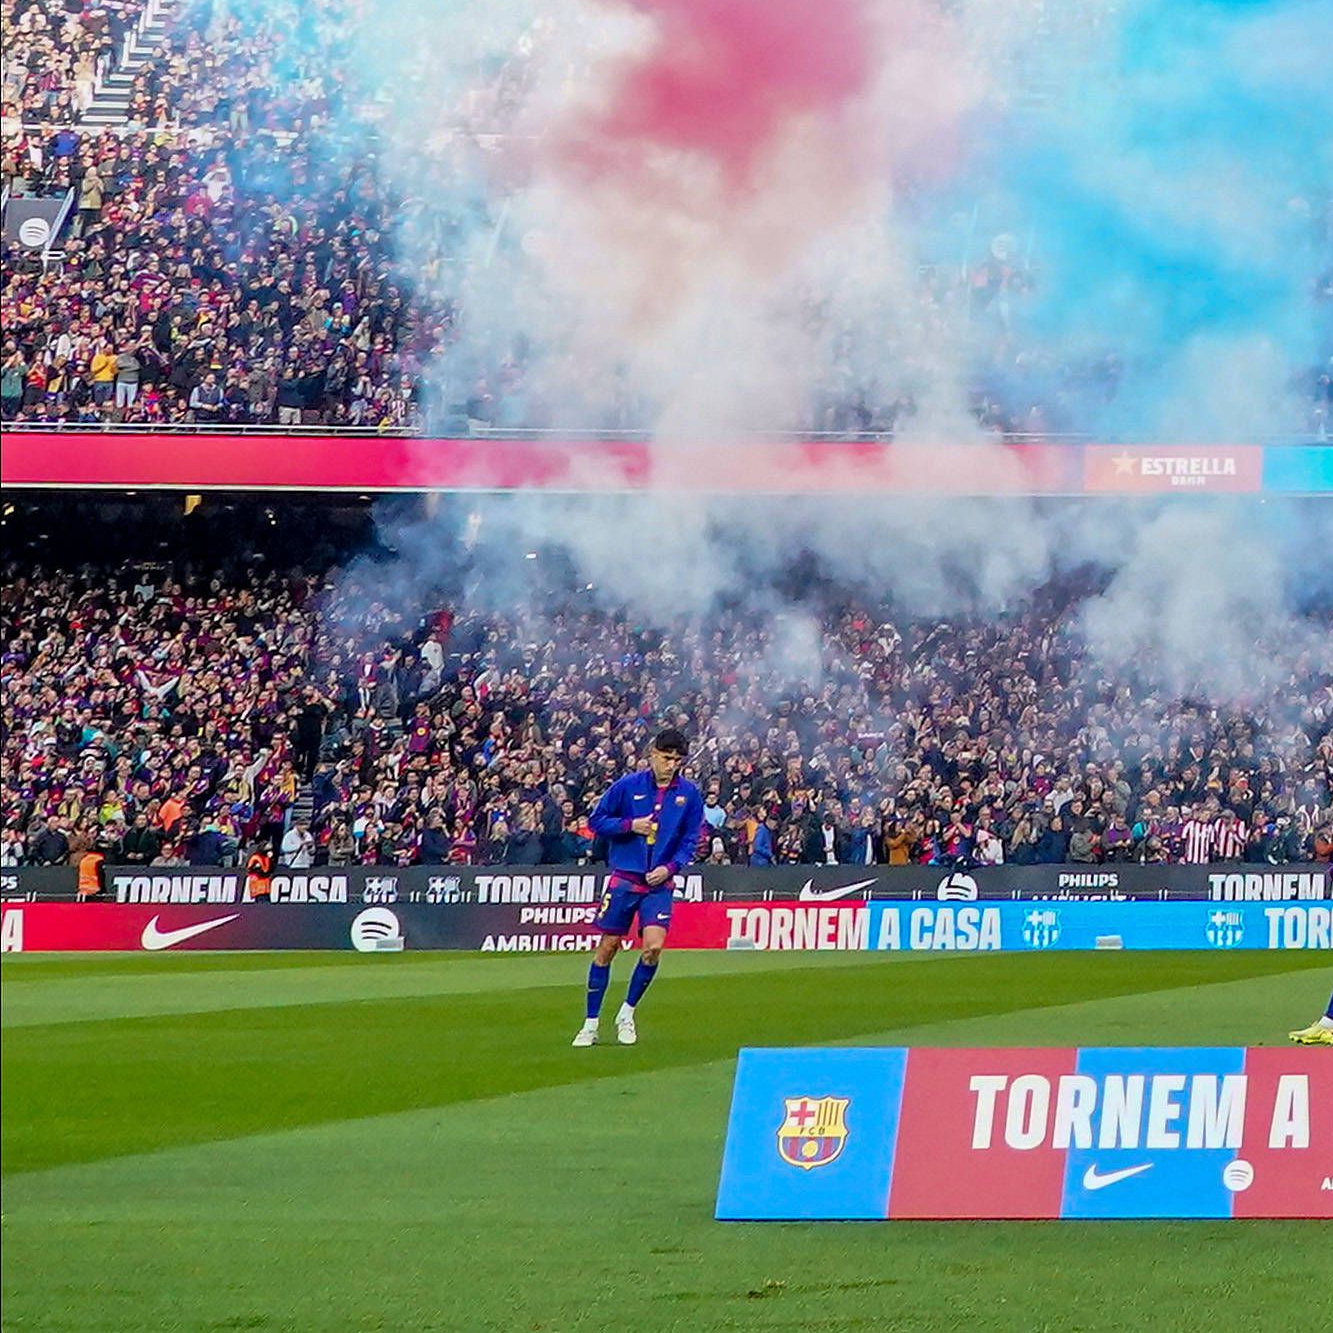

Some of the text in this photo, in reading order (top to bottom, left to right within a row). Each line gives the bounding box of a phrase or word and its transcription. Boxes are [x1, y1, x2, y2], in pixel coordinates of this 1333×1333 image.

[1140, 457, 1237, 475] ESTRELLA
[1059, 874, 1118, 887] PHILIPS
[520, 907, 597, 924] PHILIPS
[726, 907, 1000, 950] TORNEM A CASA
[968, 1074, 1248, 1150] TORNEM
[1267, 1075, 1311, 1149] A
